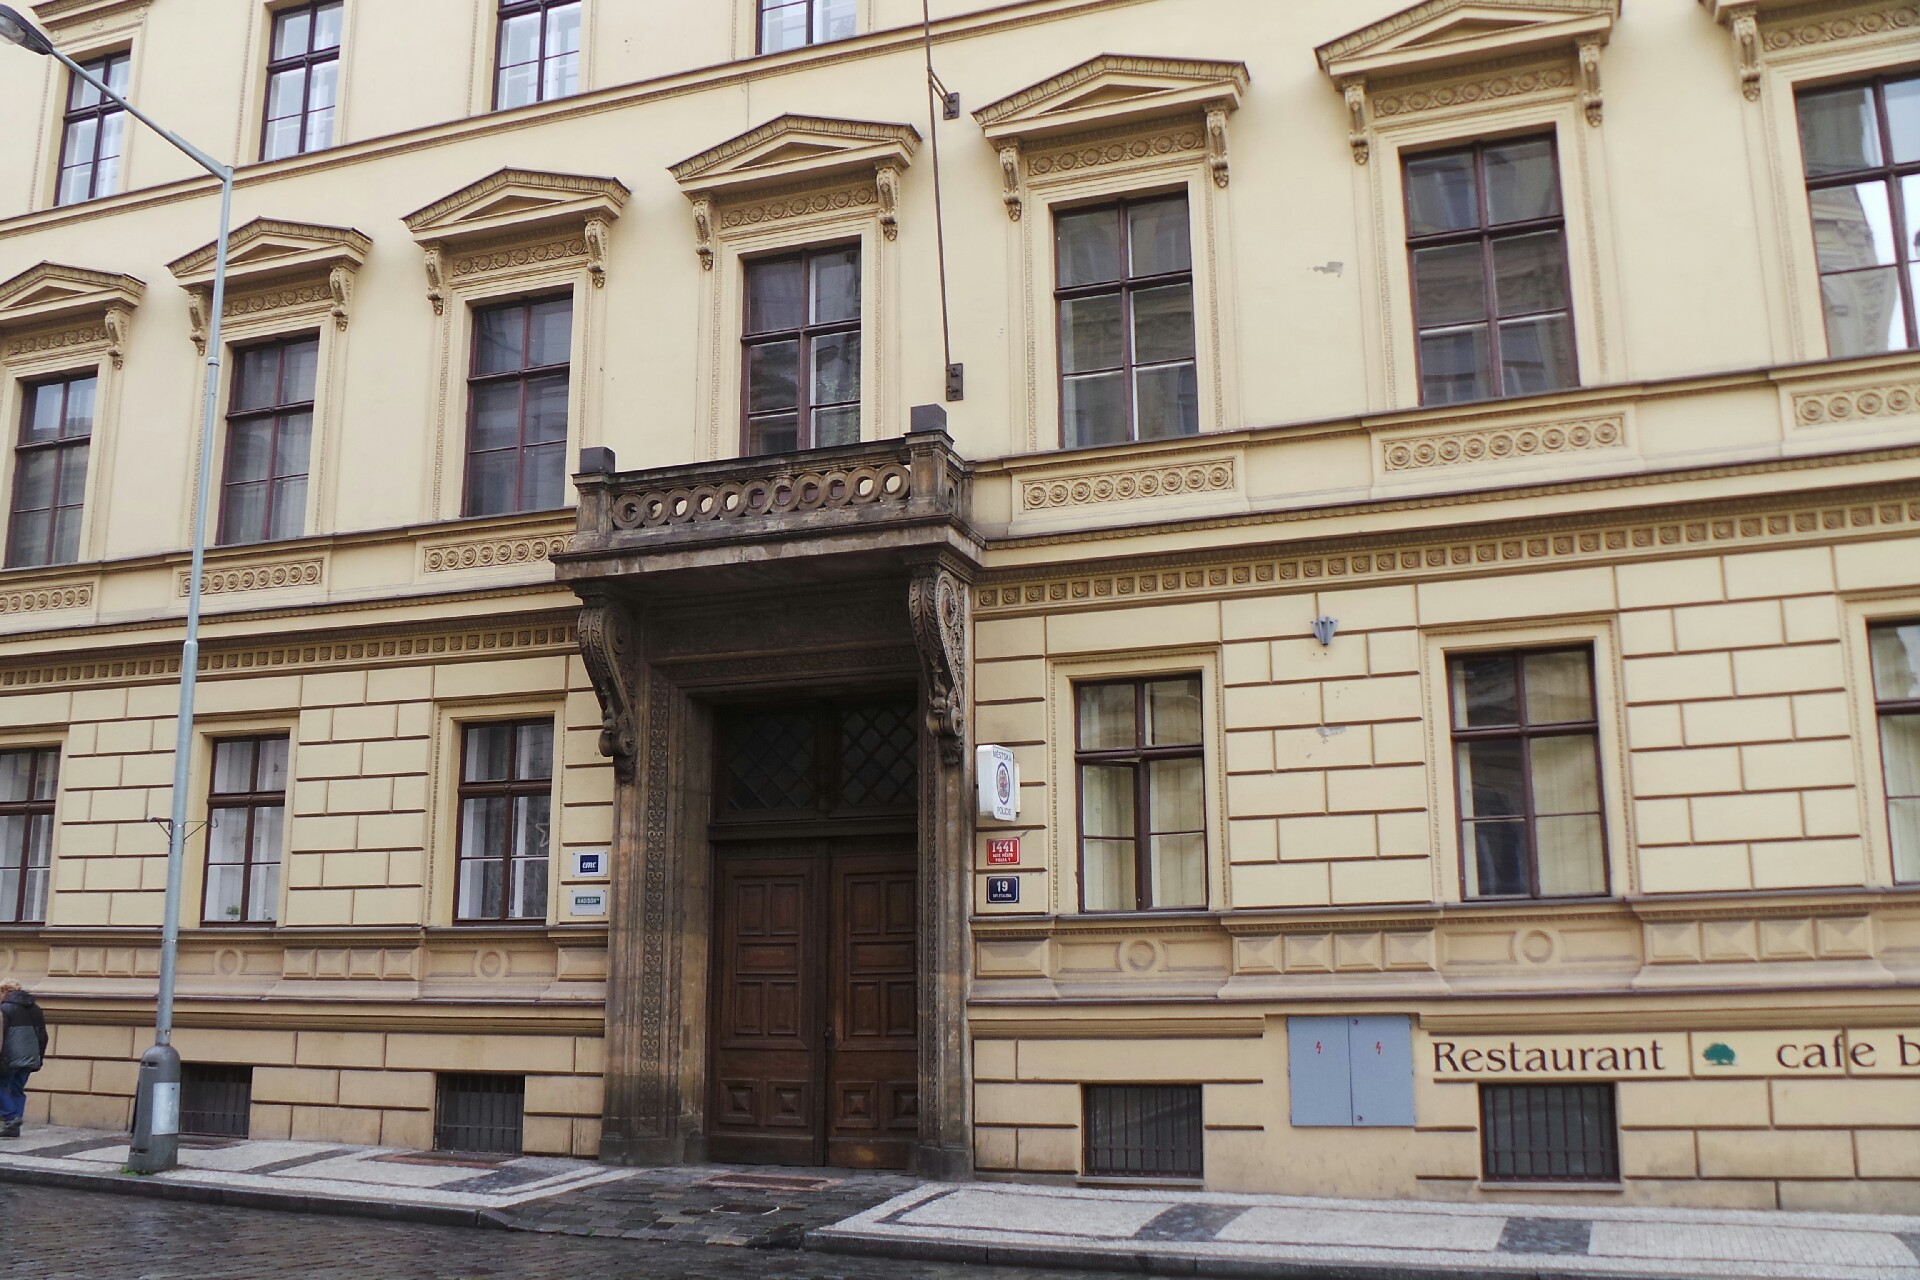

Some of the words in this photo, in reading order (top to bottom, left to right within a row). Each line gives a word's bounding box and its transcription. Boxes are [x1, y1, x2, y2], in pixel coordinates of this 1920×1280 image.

[992, 841, 1014, 852] 1441
[996, 880, 1008, 892] 19
[1432, 1039, 1665, 1073] Restaurant
[1776, 1034, 1876, 1068] cafe
